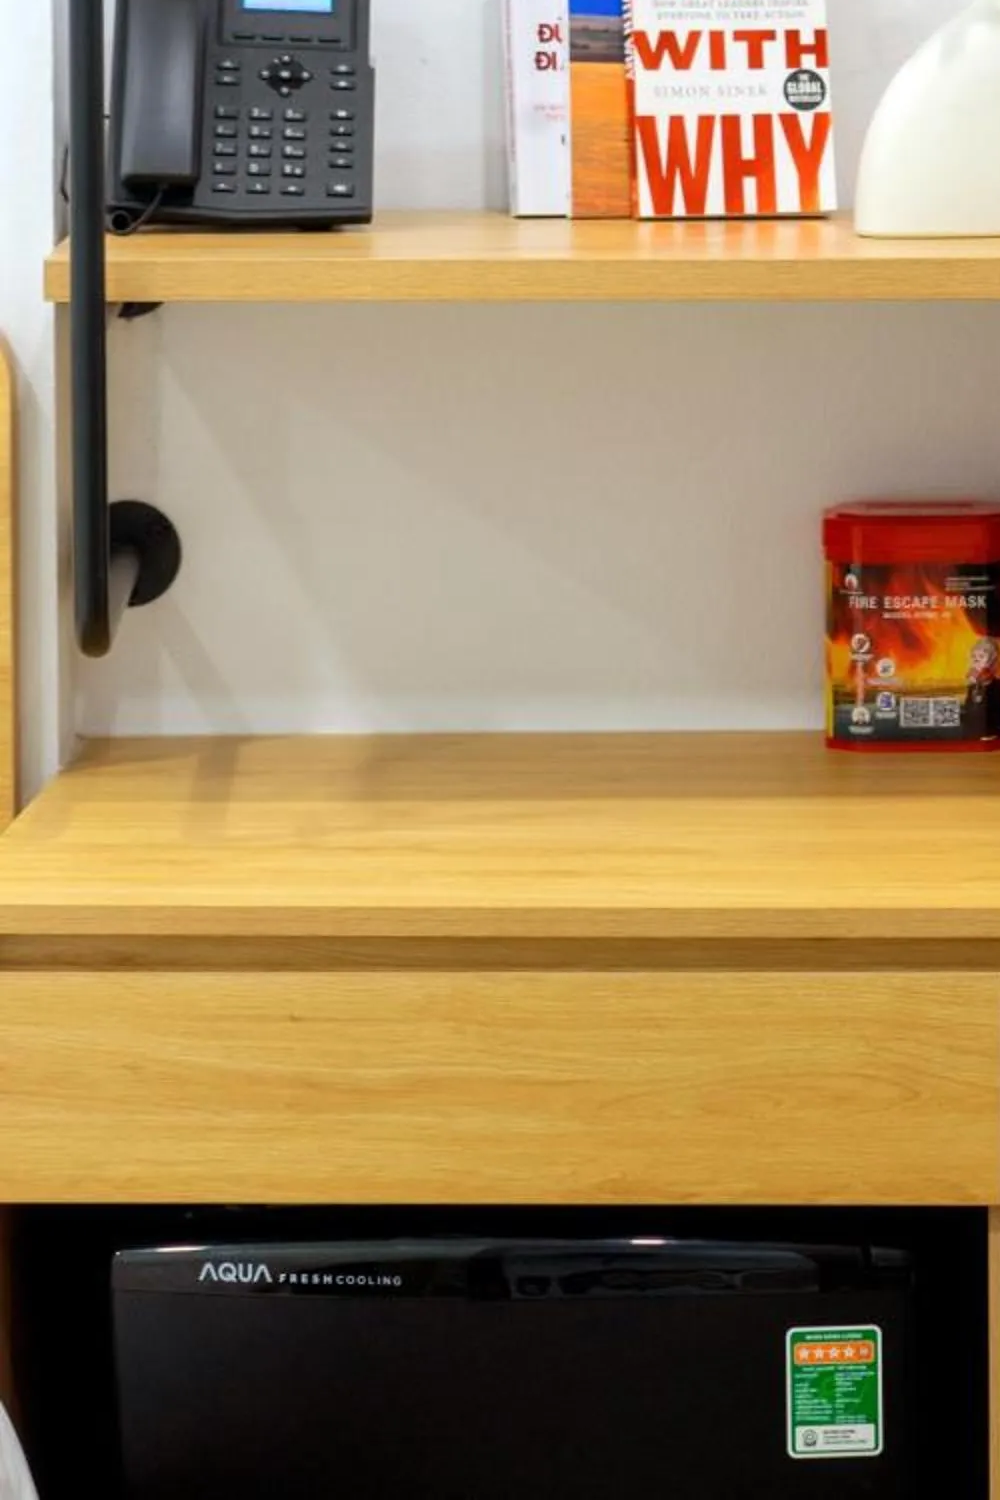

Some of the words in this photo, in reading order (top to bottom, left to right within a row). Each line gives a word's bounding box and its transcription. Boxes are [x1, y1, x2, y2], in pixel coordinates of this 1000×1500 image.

[633, 30, 829, 70] WITH
[635, 113, 832, 215] WHY
[848, 595, 878, 609] FIRE
[883, 595, 938, 609] ESCAPE
[945, 594, 987, 609] MASK
[199, 1262, 273, 1283] AQUA
